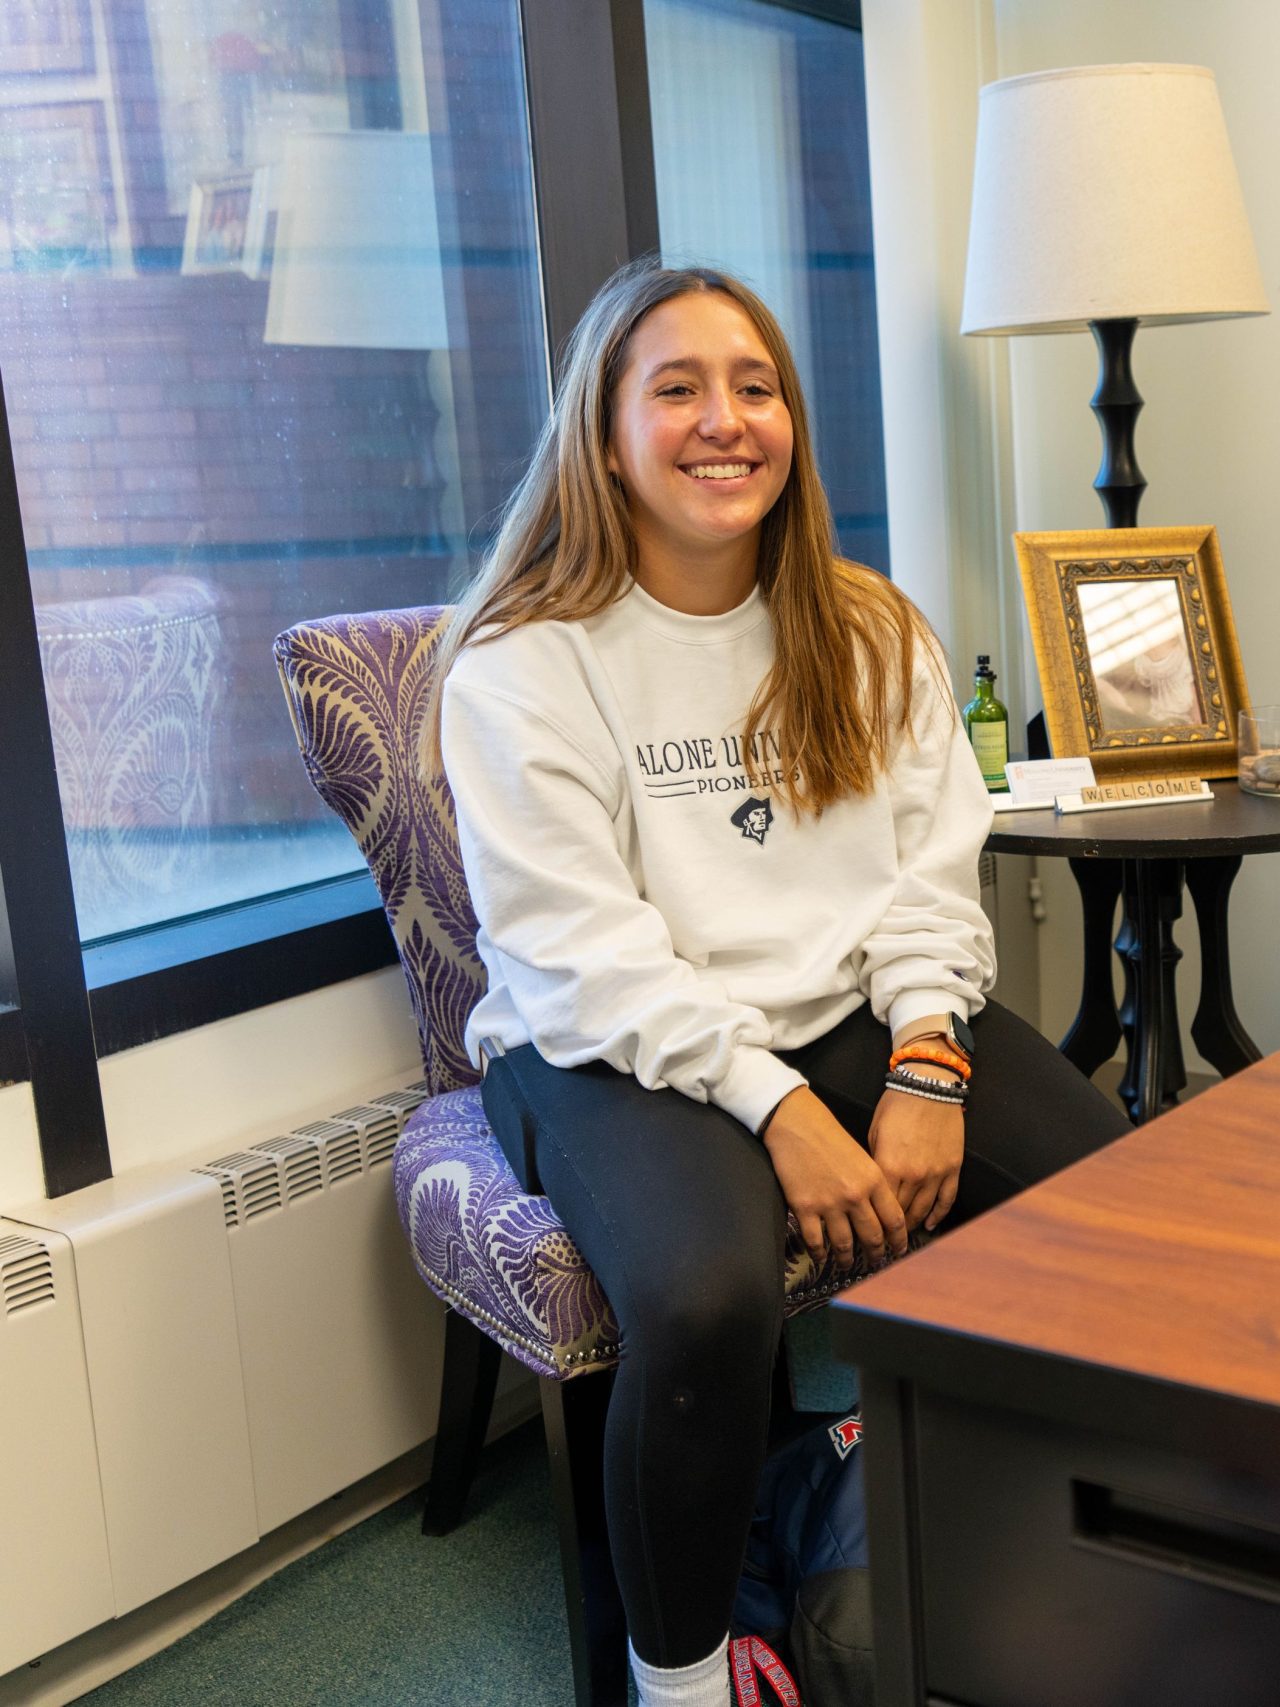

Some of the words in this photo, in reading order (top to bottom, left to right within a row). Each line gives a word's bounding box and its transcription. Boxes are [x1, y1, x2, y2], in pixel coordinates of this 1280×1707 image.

[635, 738, 717, 775] ALONE
[720, 729, 782, 768] UNIV
[1086, 780, 1198, 801] WELCOME
